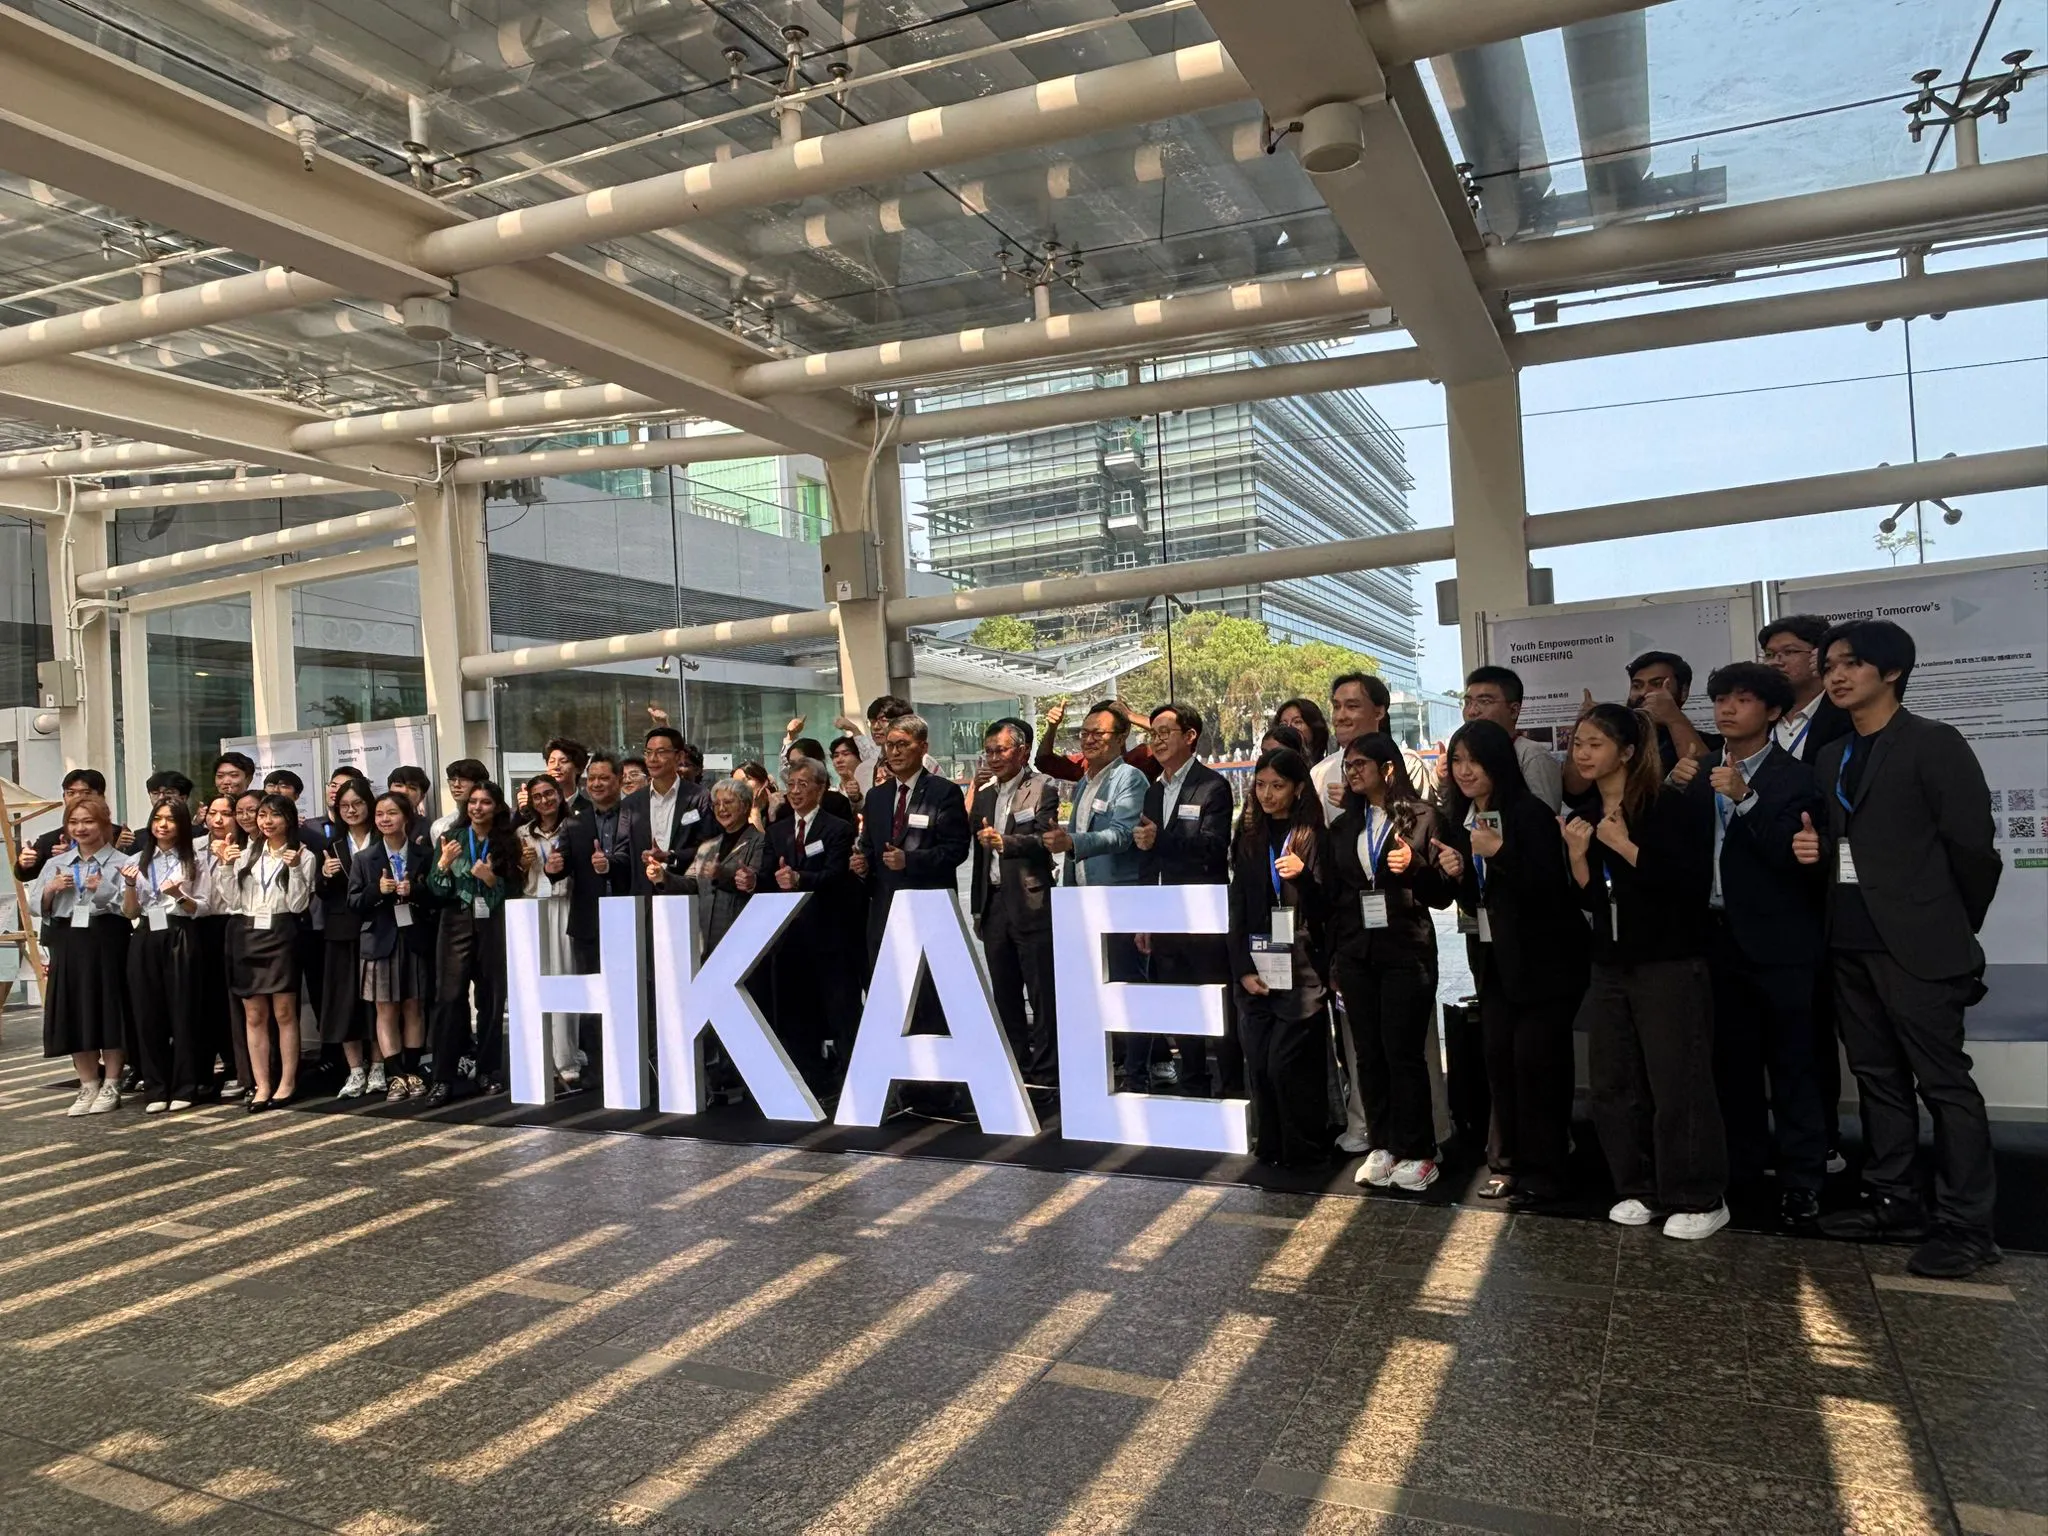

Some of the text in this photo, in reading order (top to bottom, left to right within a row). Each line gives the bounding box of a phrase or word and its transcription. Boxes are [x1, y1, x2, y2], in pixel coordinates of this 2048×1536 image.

[1876, 602, 1940, 616] Tomorrow's
[1510, 633, 1614, 652] Youth Empowerment in
[1510, 650, 1573, 664] ENGINEERING
[505, 885, 1249, 1154] HKAE
